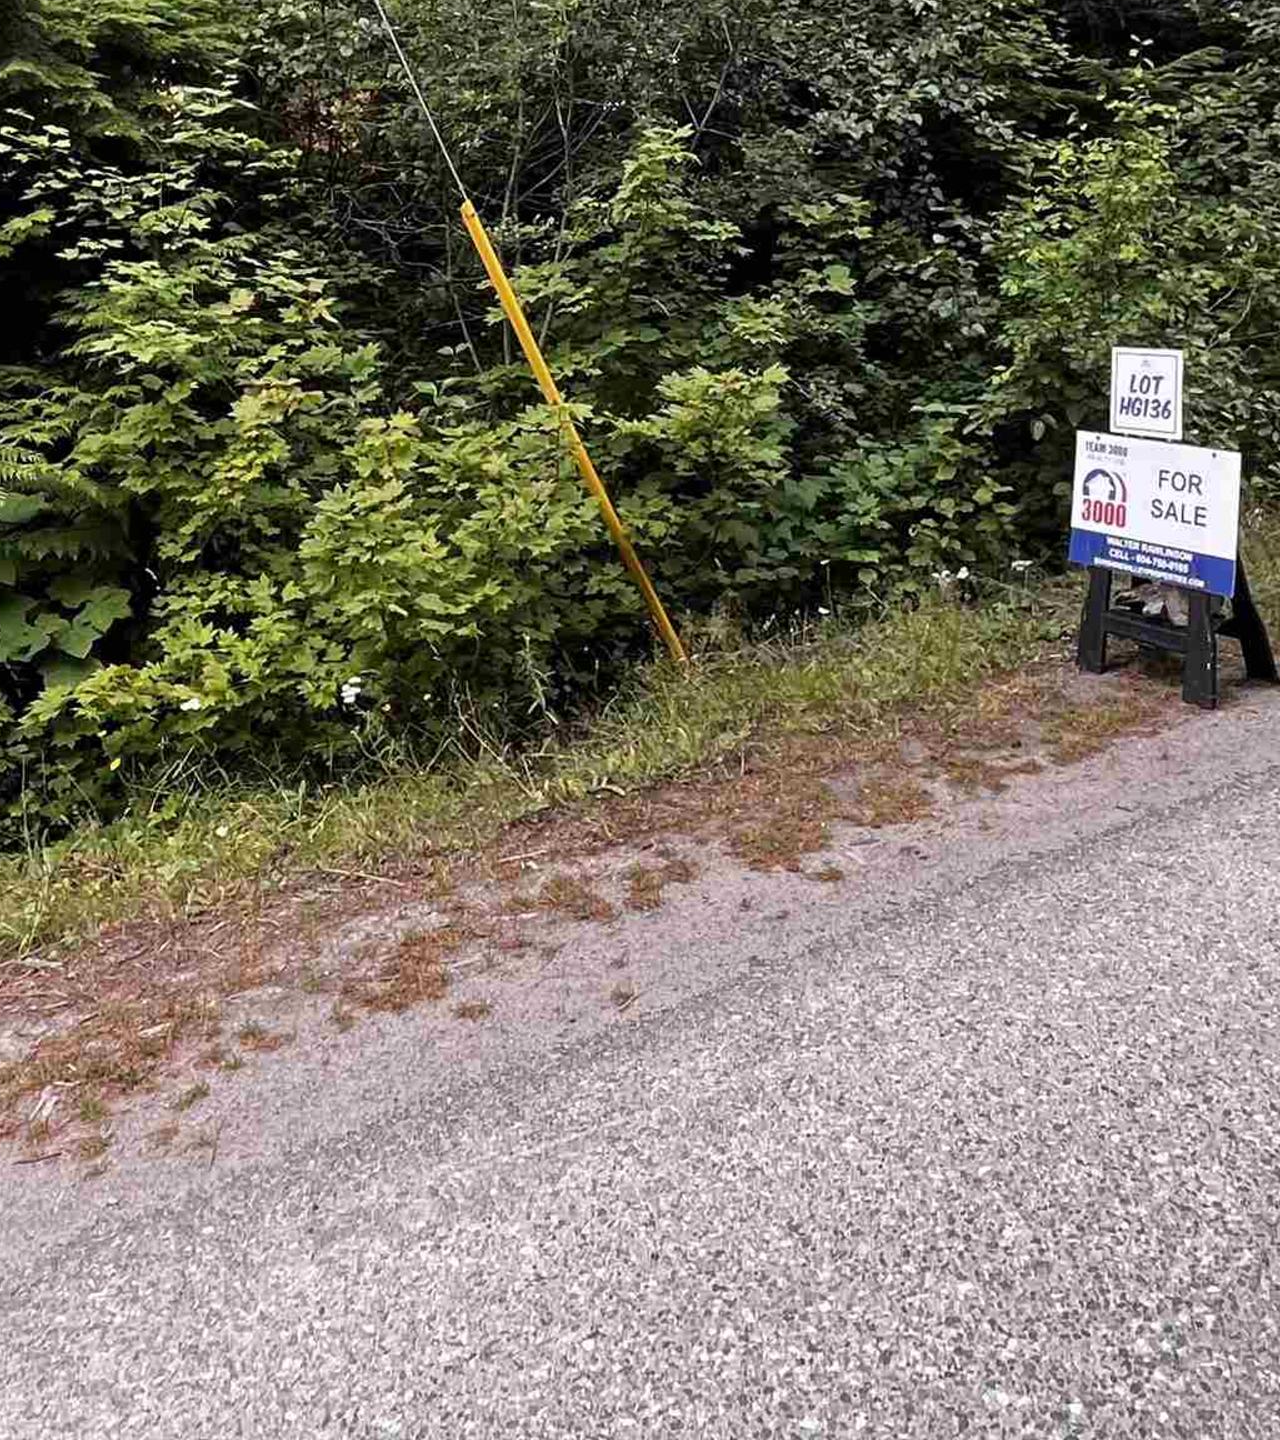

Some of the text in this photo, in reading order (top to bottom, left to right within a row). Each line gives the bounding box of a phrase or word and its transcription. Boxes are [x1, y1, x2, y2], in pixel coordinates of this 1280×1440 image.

[1129, 373, 1165, 395] LOT
[1119, 396, 1172, 420] HG136
[1158, 469, 1203, 496] FOR
[1081, 498, 1127, 529] 3000
[1151, 498, 1208, 528] SALE
[1109, 547, 1130, 561] CELL
